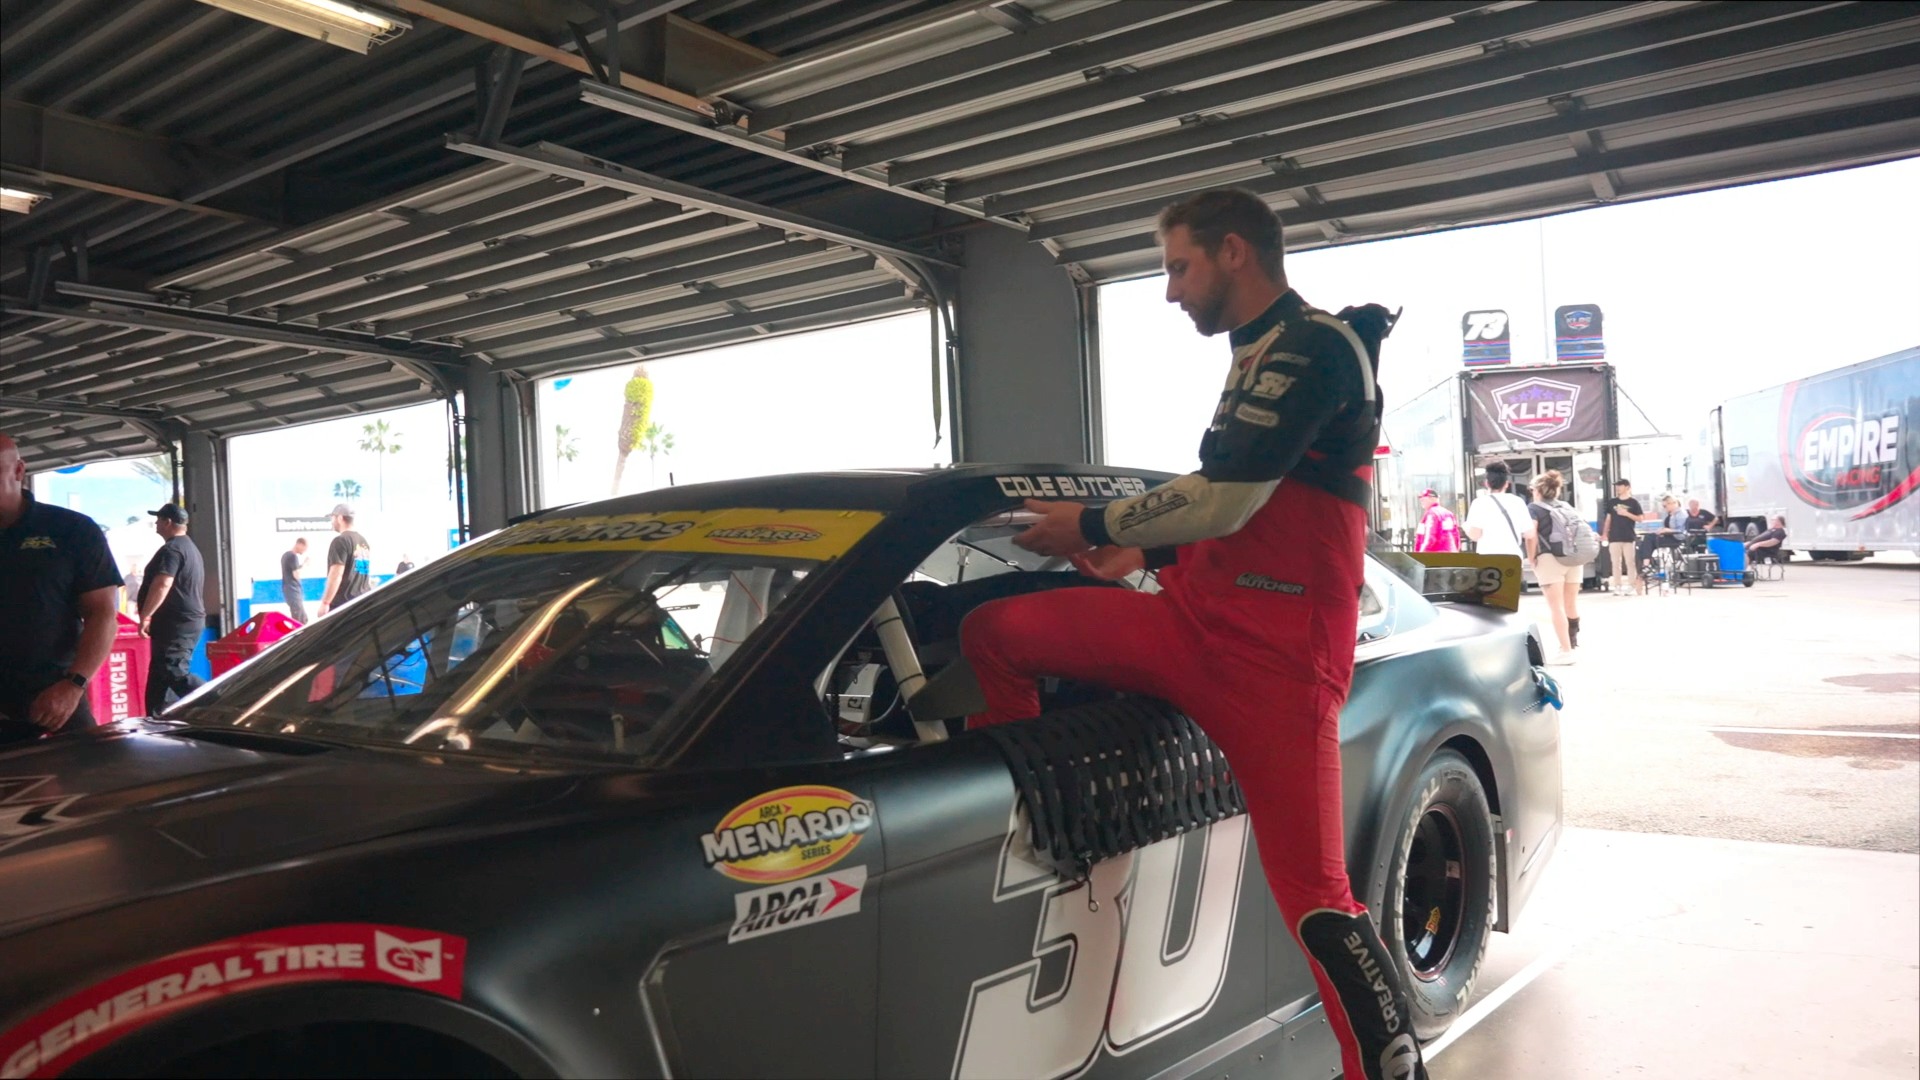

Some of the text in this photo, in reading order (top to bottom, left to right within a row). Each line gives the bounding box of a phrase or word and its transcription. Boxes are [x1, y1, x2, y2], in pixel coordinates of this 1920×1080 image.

[1464, 311, 1508, 340] 73
[1501, 400, 1573, 420] KLAS
[1804, 412, 1899, 471] EMPIRE
[995, 476, 1147, 497] COLE BUTCHER
[759, 804, 782, 819] ARCA
[701, 801, 873, 867] MENARDS
[802, 844, 832, 861] SERIES
[732, 882, 822, 936] ARCA
[1343, 931, 1400, 1033] CREATIVE
[0, 944, 365, 1079] GENERAL TIRE
